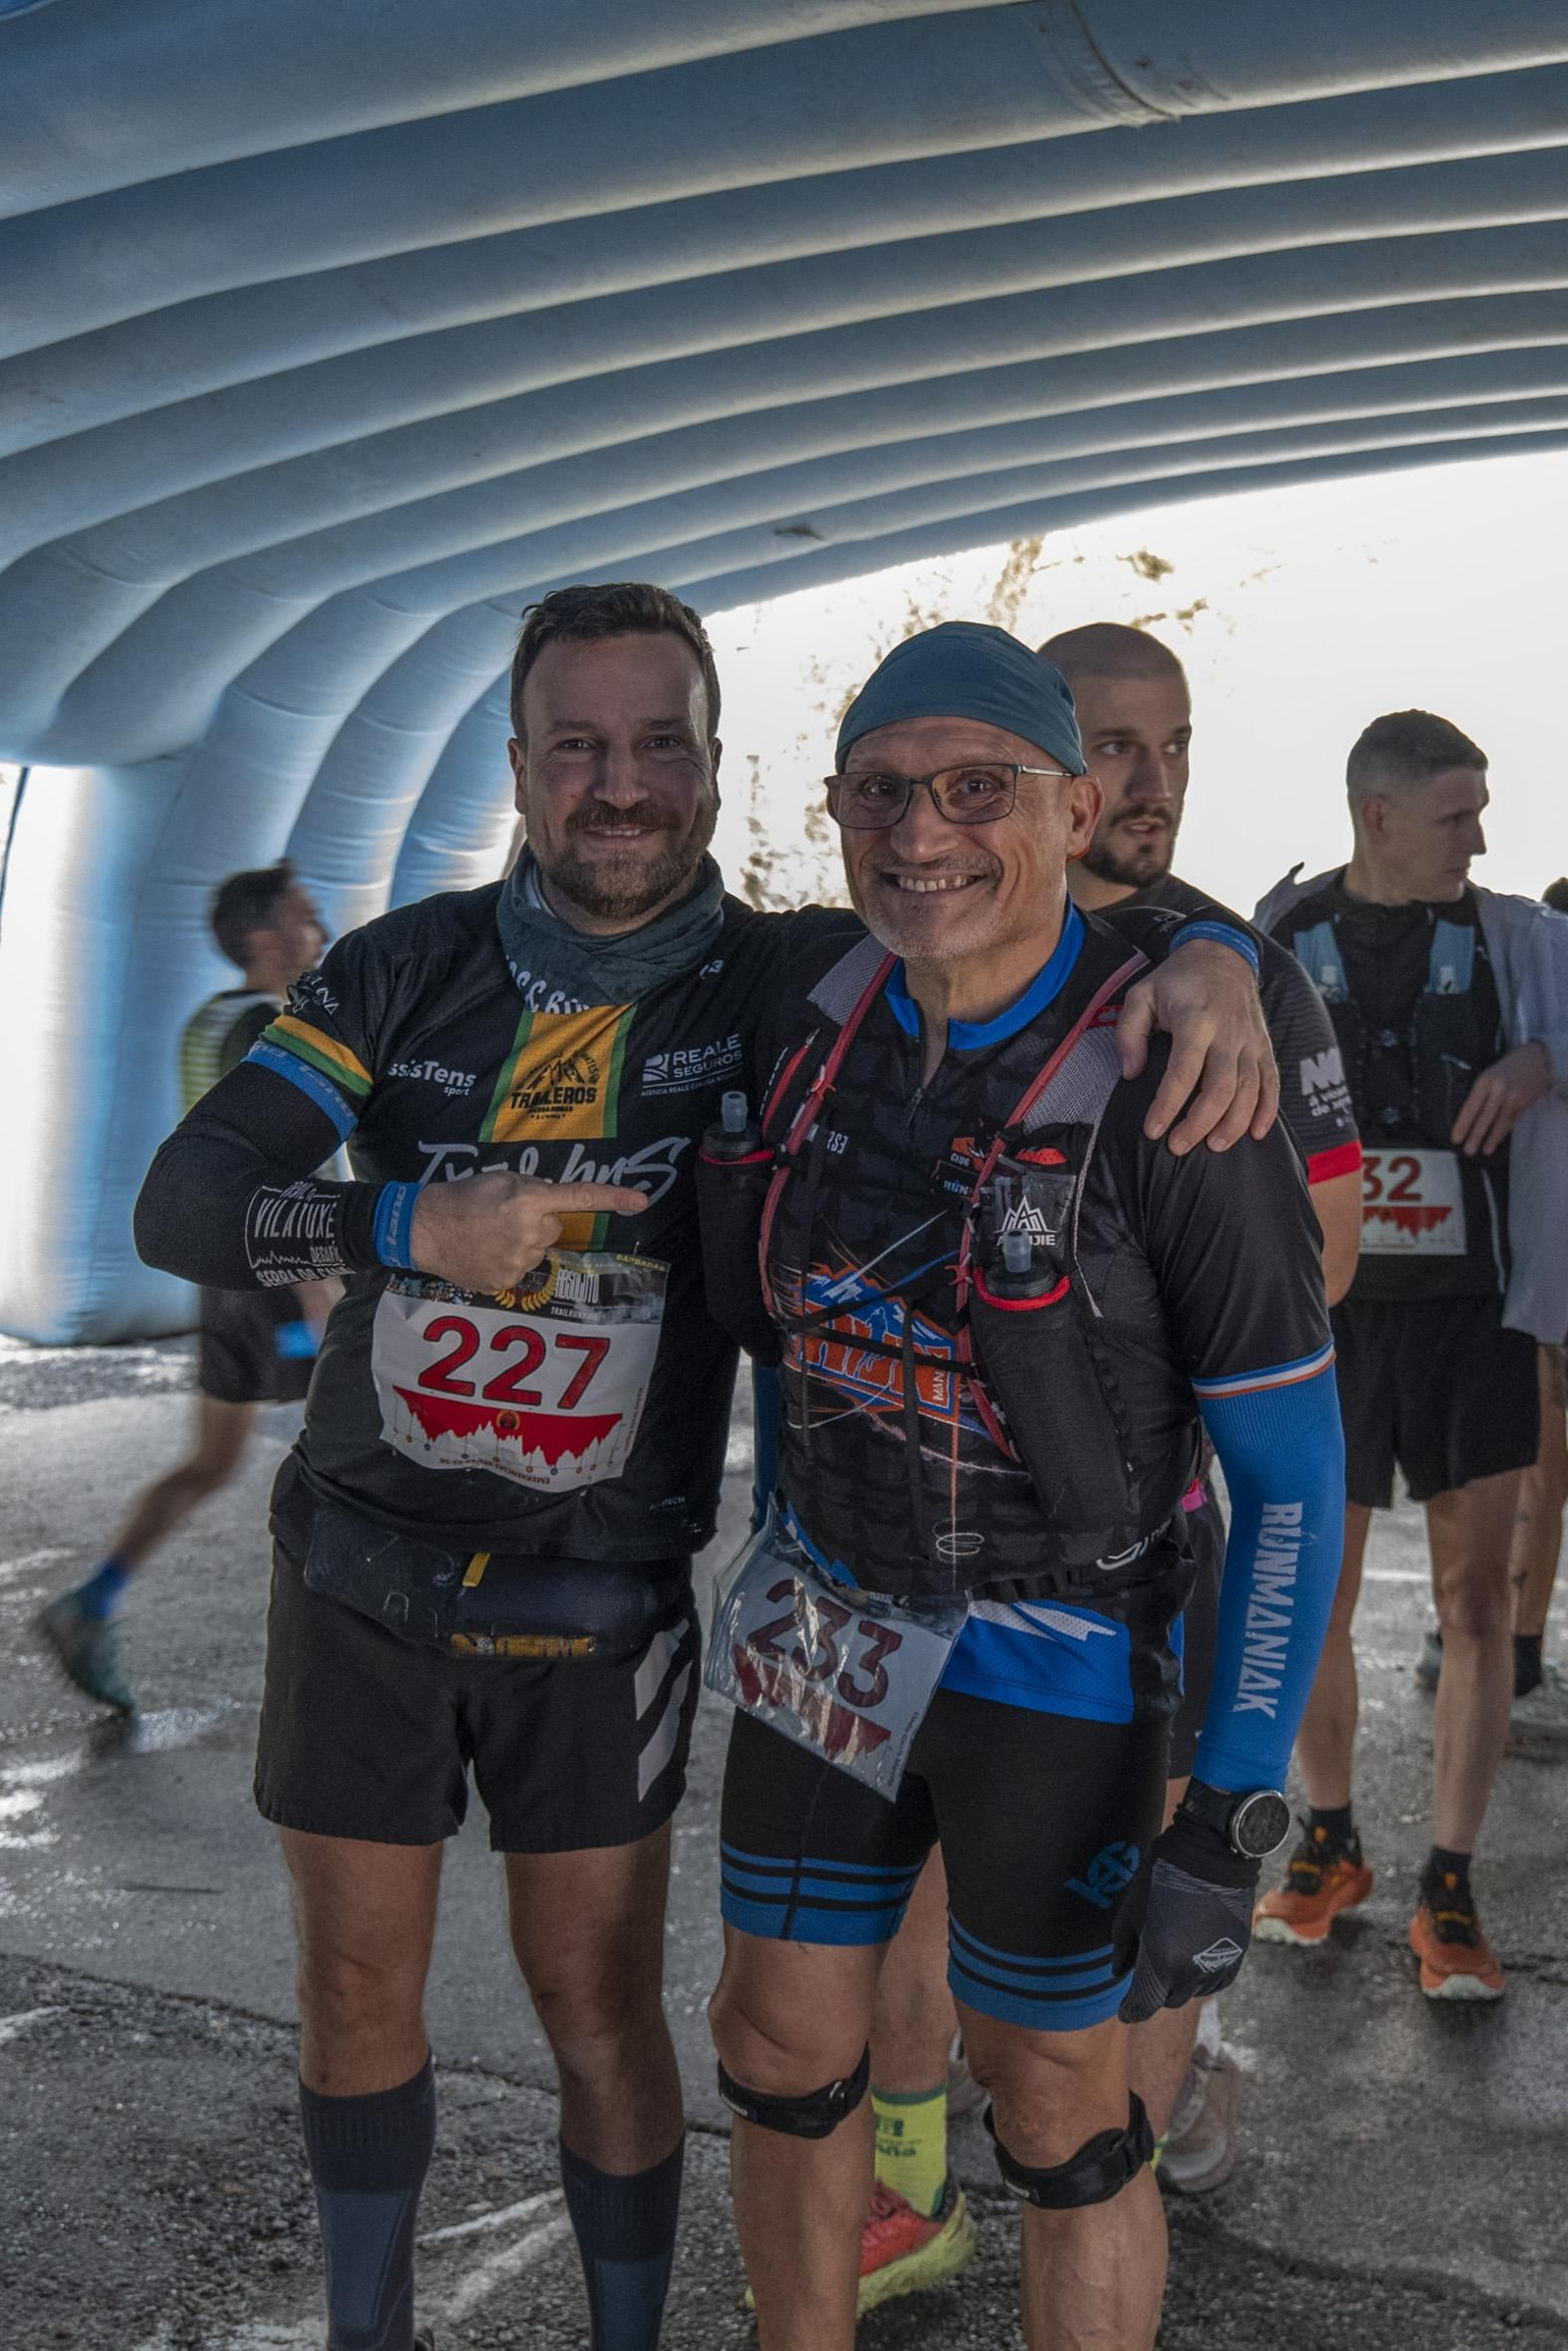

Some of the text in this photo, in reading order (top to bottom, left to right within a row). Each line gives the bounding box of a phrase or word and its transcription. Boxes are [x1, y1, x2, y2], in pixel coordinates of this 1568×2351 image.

[673, 1033, 742, 1066] REALE
[673, 1050, 743, 1078] SEGUROS
[444, 1087, 469, 1097] sport
[417, 1315, 611, 1410] 227
[1232, 1501, 1303, 1720] RUNMANIAK
[747, 1578, 904, 1709] 233
